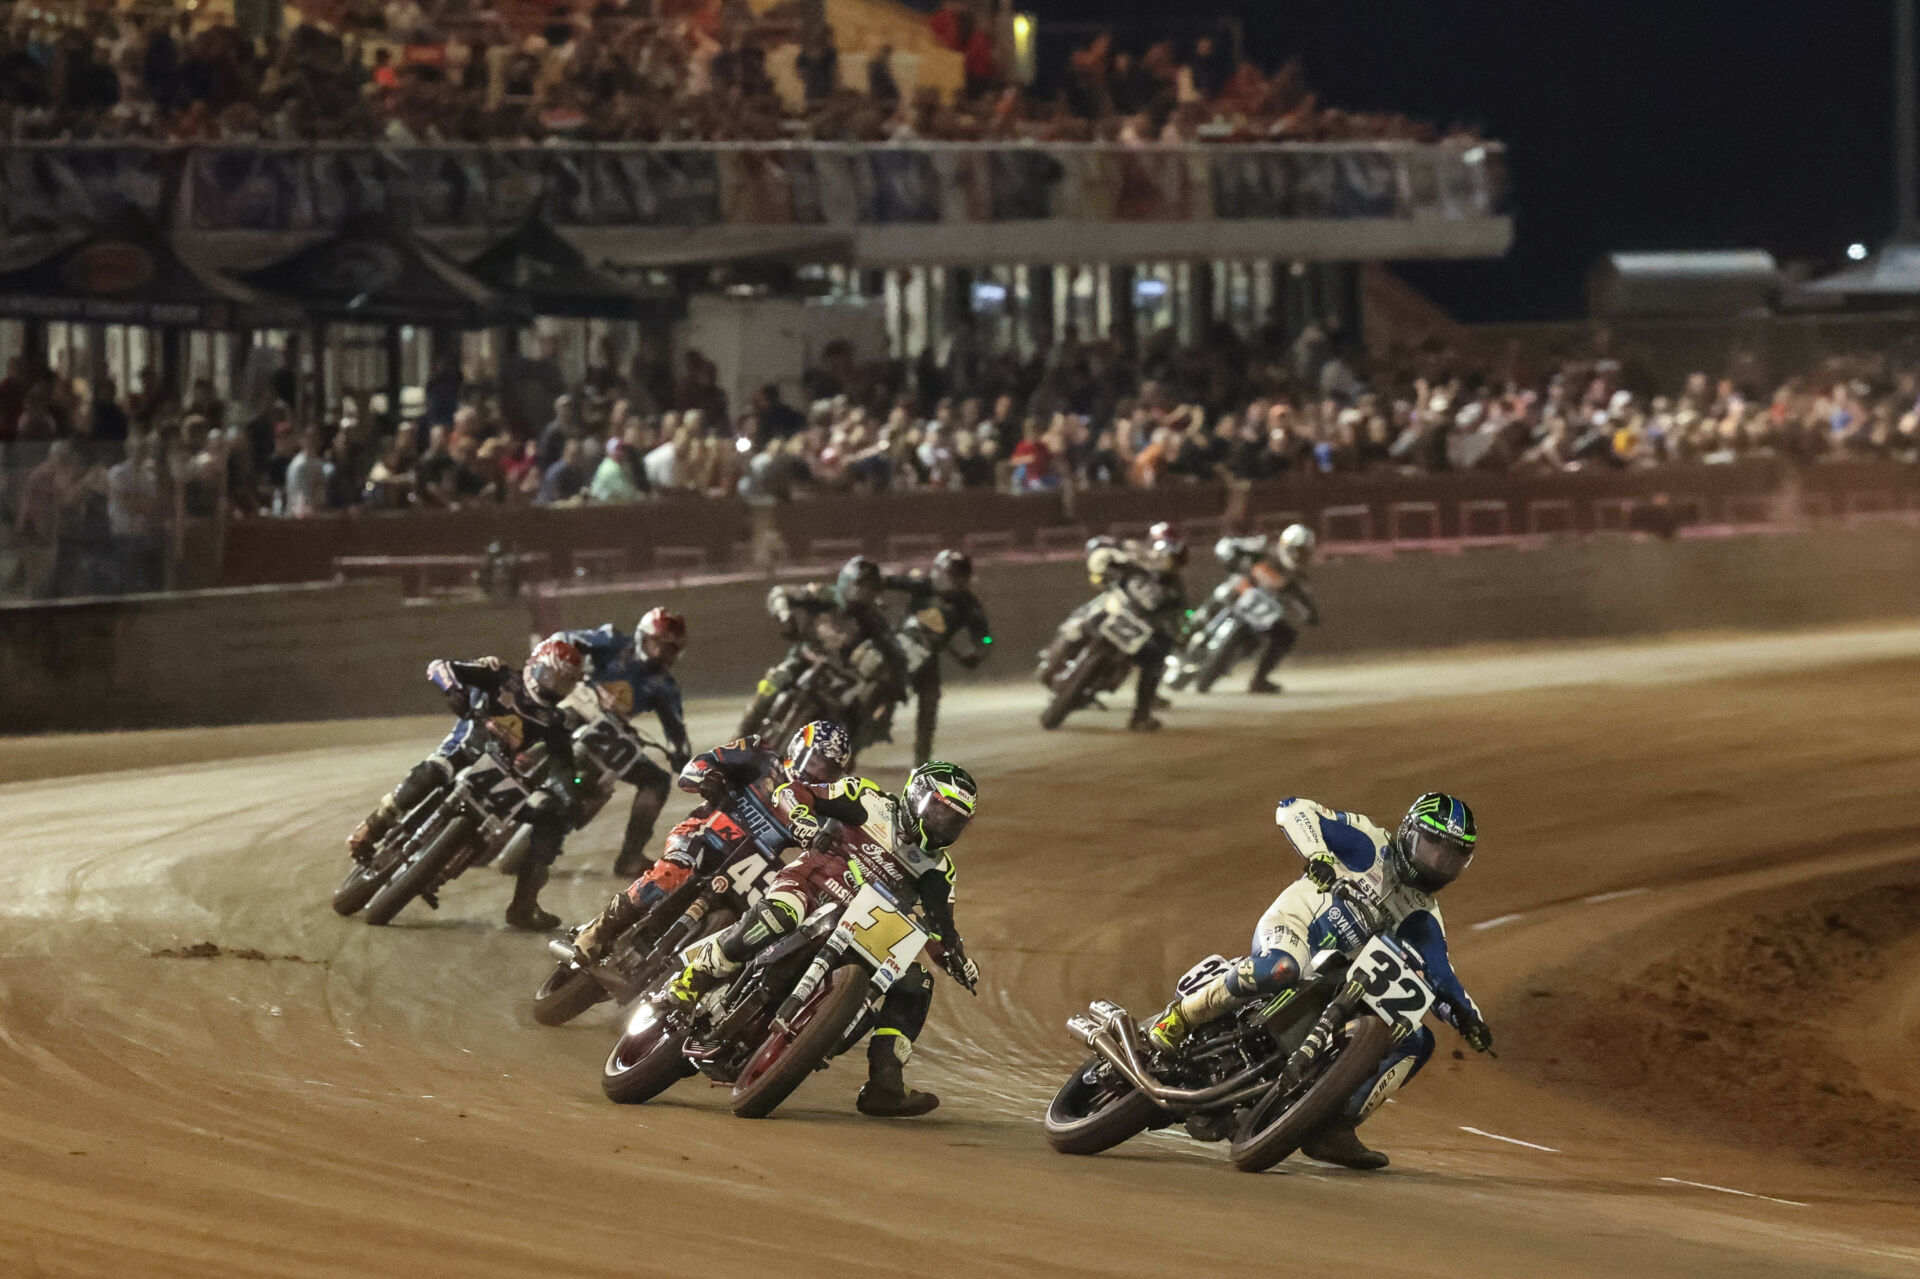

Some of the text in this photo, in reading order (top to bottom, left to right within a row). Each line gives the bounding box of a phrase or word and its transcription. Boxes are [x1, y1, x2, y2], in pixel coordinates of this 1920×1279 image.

[861, 843, 904, 881] Indian
[853, 905, 916, 965] 1
[1365, 949, 1427, 1024] 32
